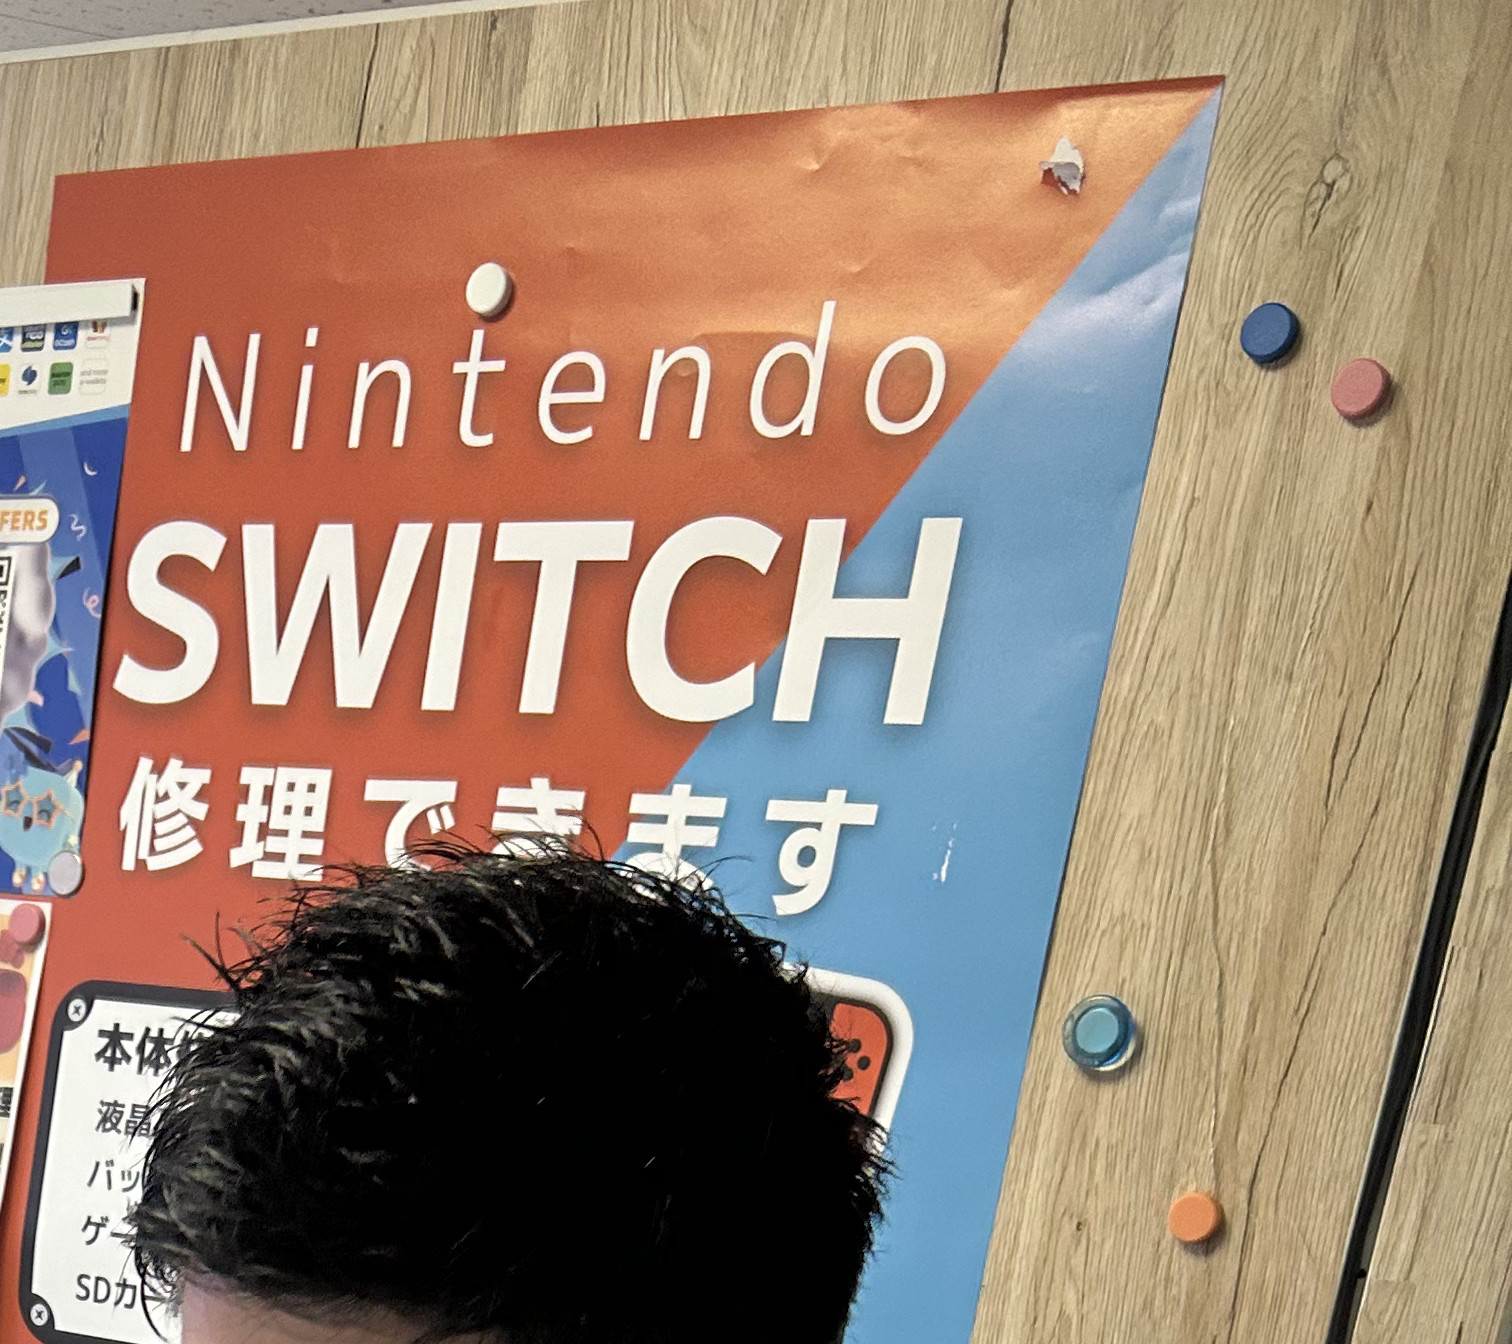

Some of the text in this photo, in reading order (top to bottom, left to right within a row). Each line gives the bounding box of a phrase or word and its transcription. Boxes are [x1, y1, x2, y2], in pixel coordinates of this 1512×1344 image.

[179, 300, 946, 453] Nintendo
[113, 516, 963, 726] SWITCH
[119, 755, 878, 917] 修理できます
[87, 1159, 139, 1192] バッ
[82, 1215, 138, 1246] ゲー
[76, 1273, 170, 1309] SDカー
